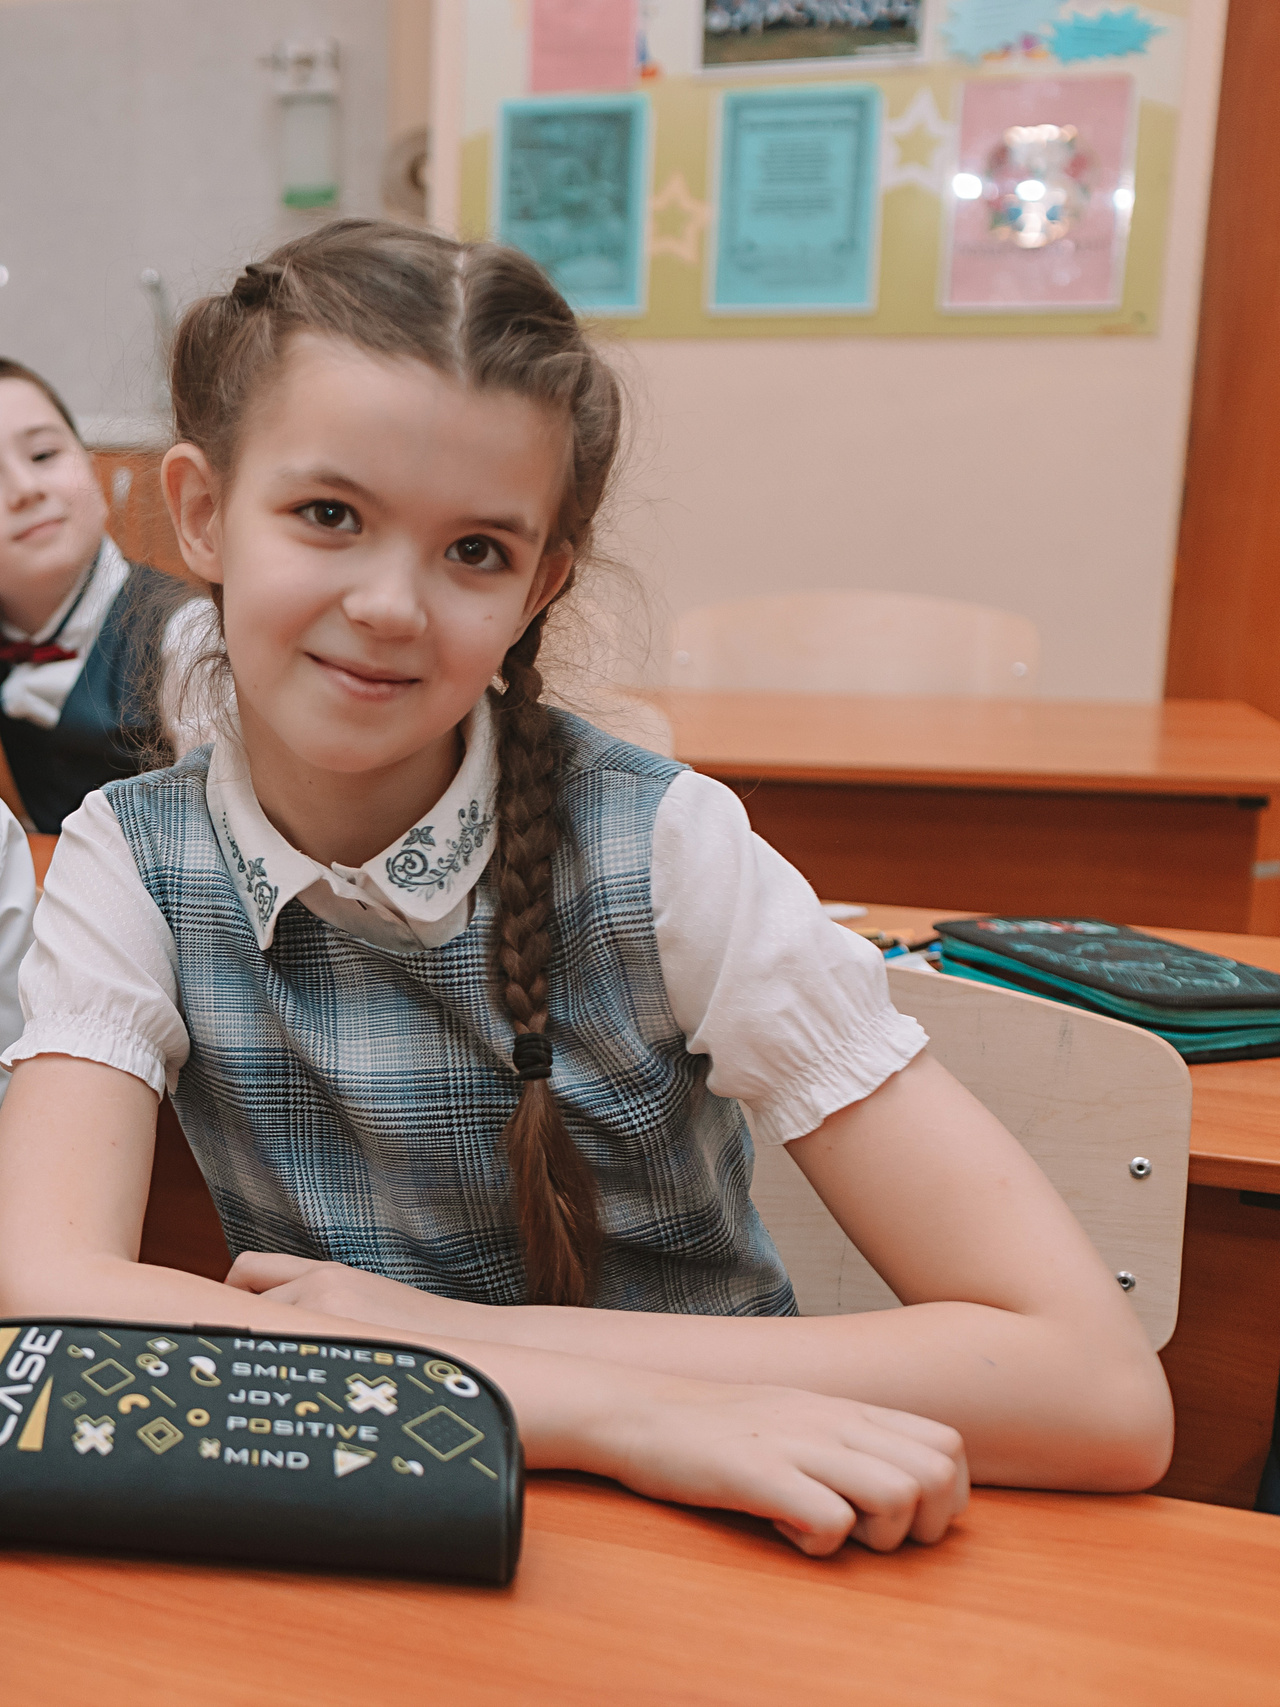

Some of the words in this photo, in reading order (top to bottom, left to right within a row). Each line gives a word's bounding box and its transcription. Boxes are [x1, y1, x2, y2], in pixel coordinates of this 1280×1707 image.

[233, 1338, 417, 1368] HAPPINESS
[231, 1361, 327, 1384] SMILE
[227, 1388, 292, 1407] JOY
[226, 1415, 380, 1442] POSITIVE
[223, 1446, 310, 1470] MIND
